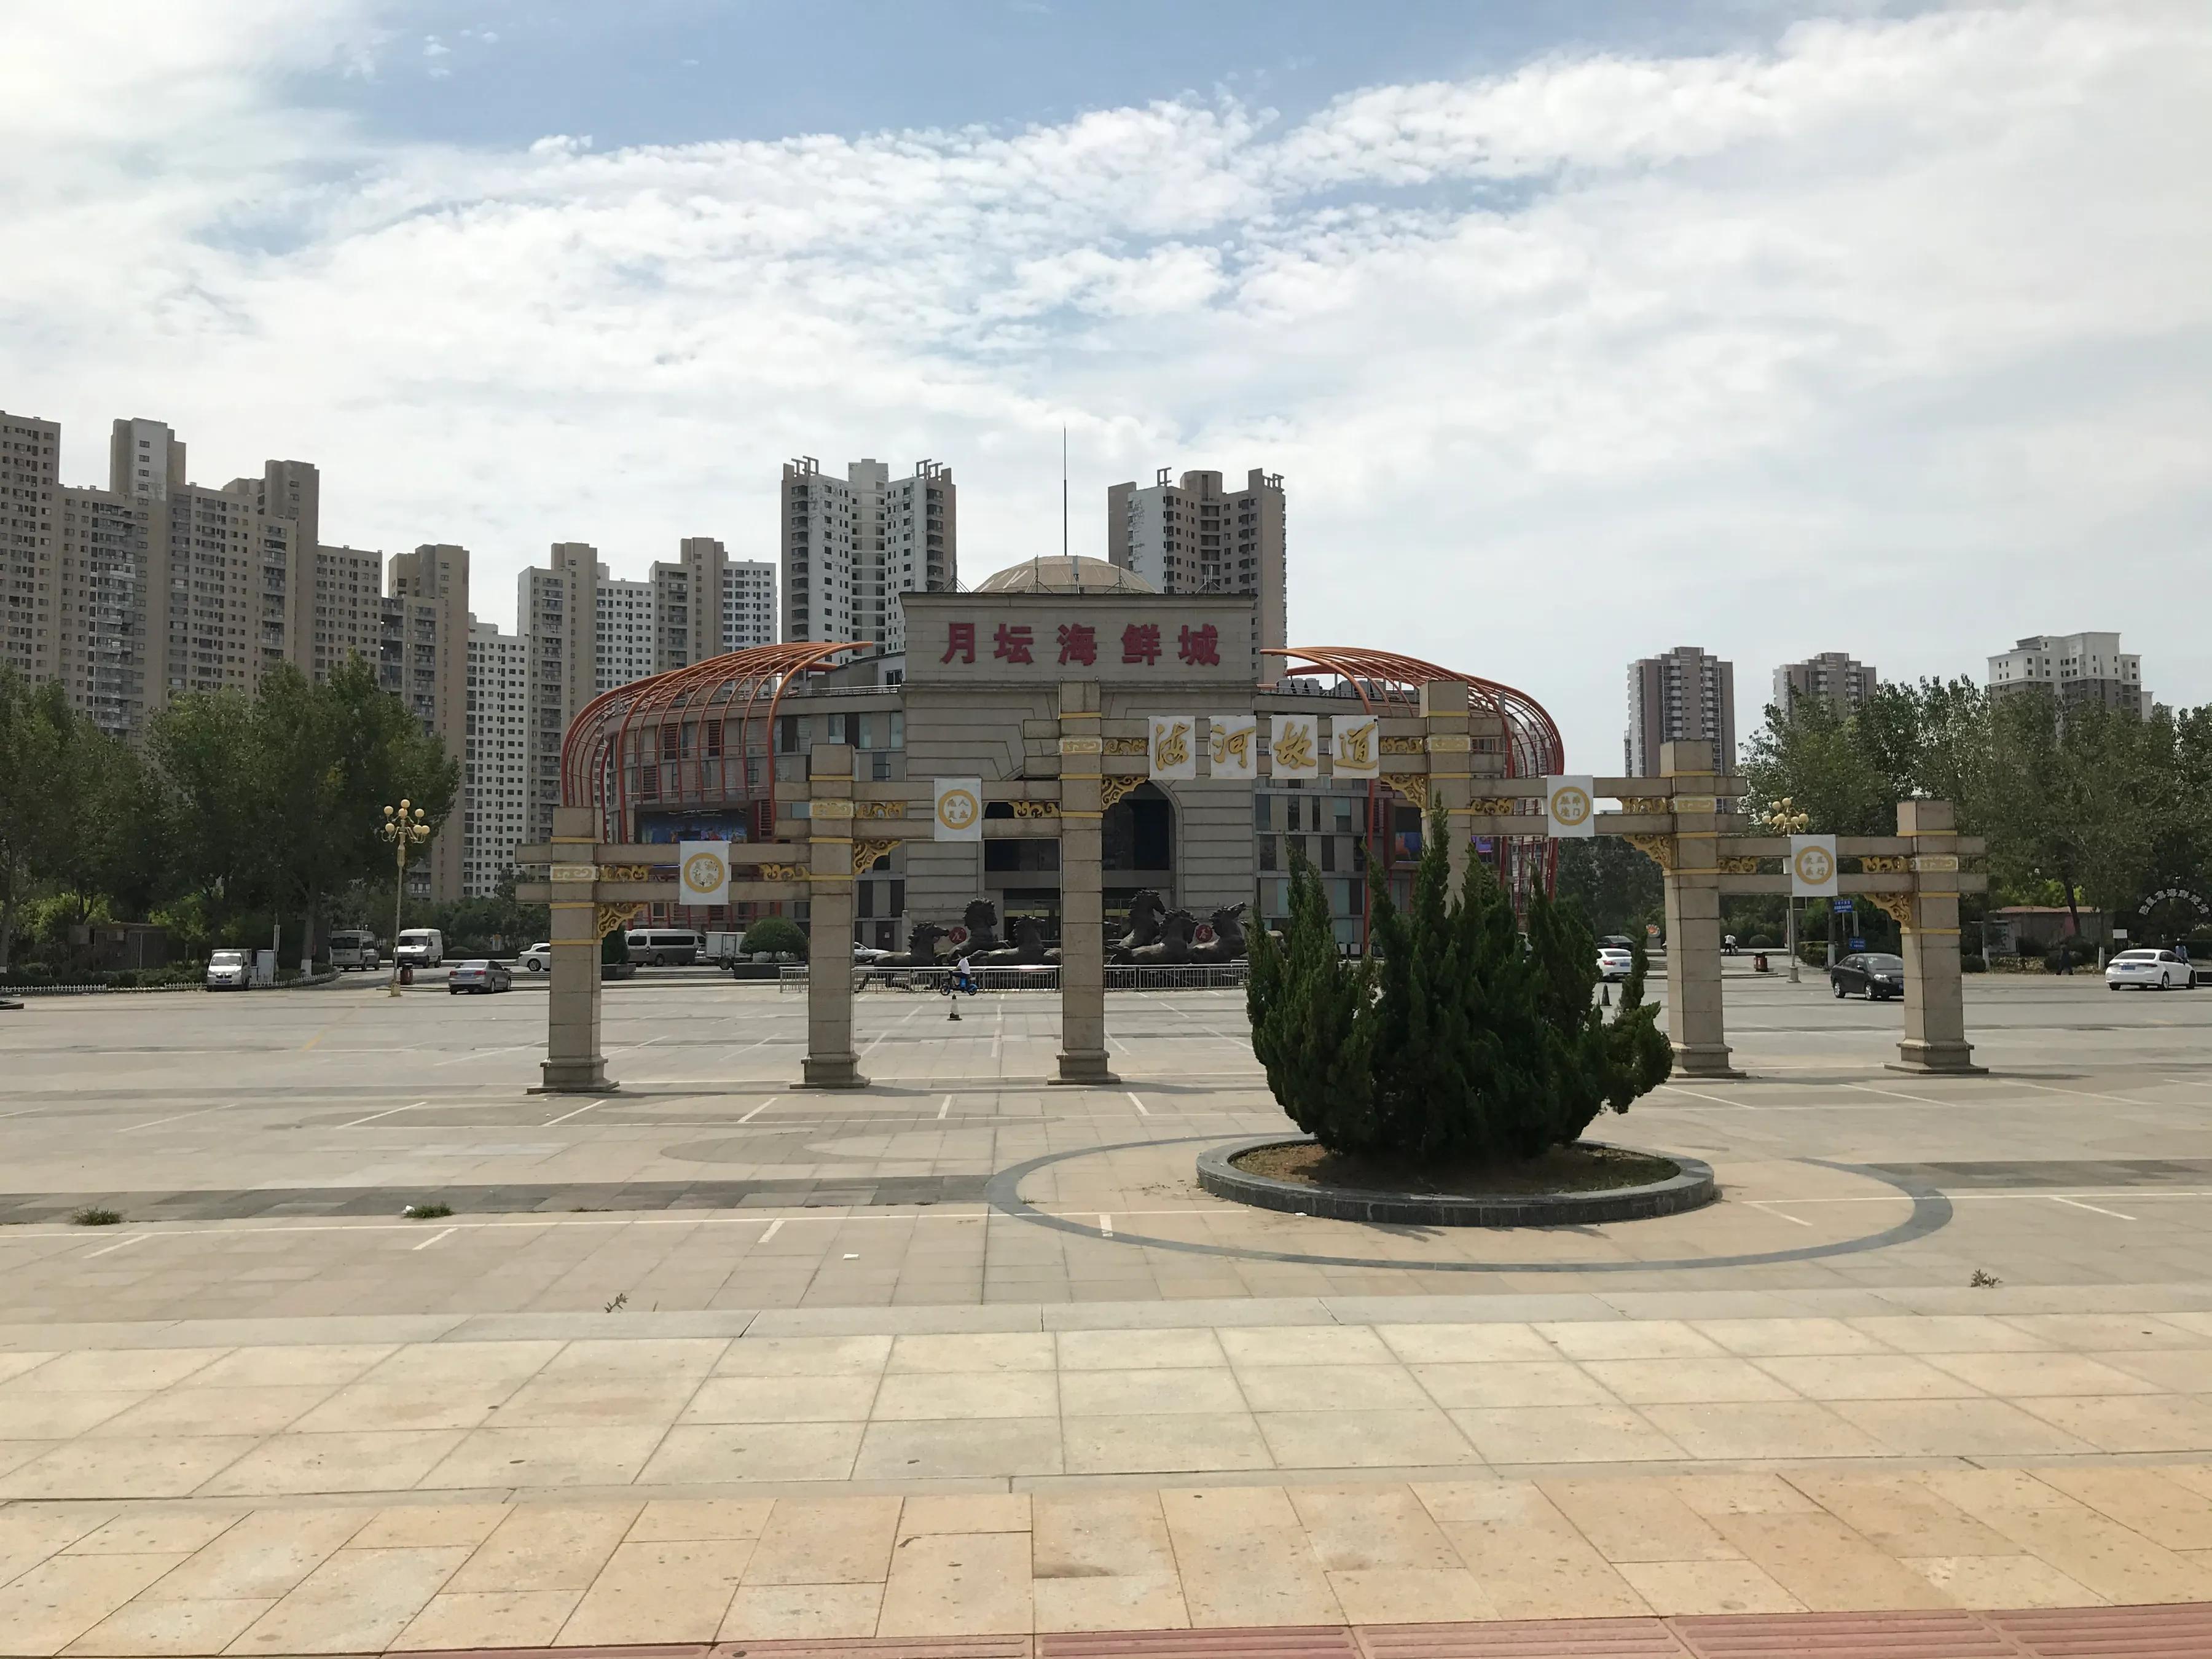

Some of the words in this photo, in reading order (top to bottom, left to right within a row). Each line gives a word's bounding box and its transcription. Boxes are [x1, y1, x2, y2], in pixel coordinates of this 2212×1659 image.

[940, 622, 1221, 666] 月坛海鲜城
